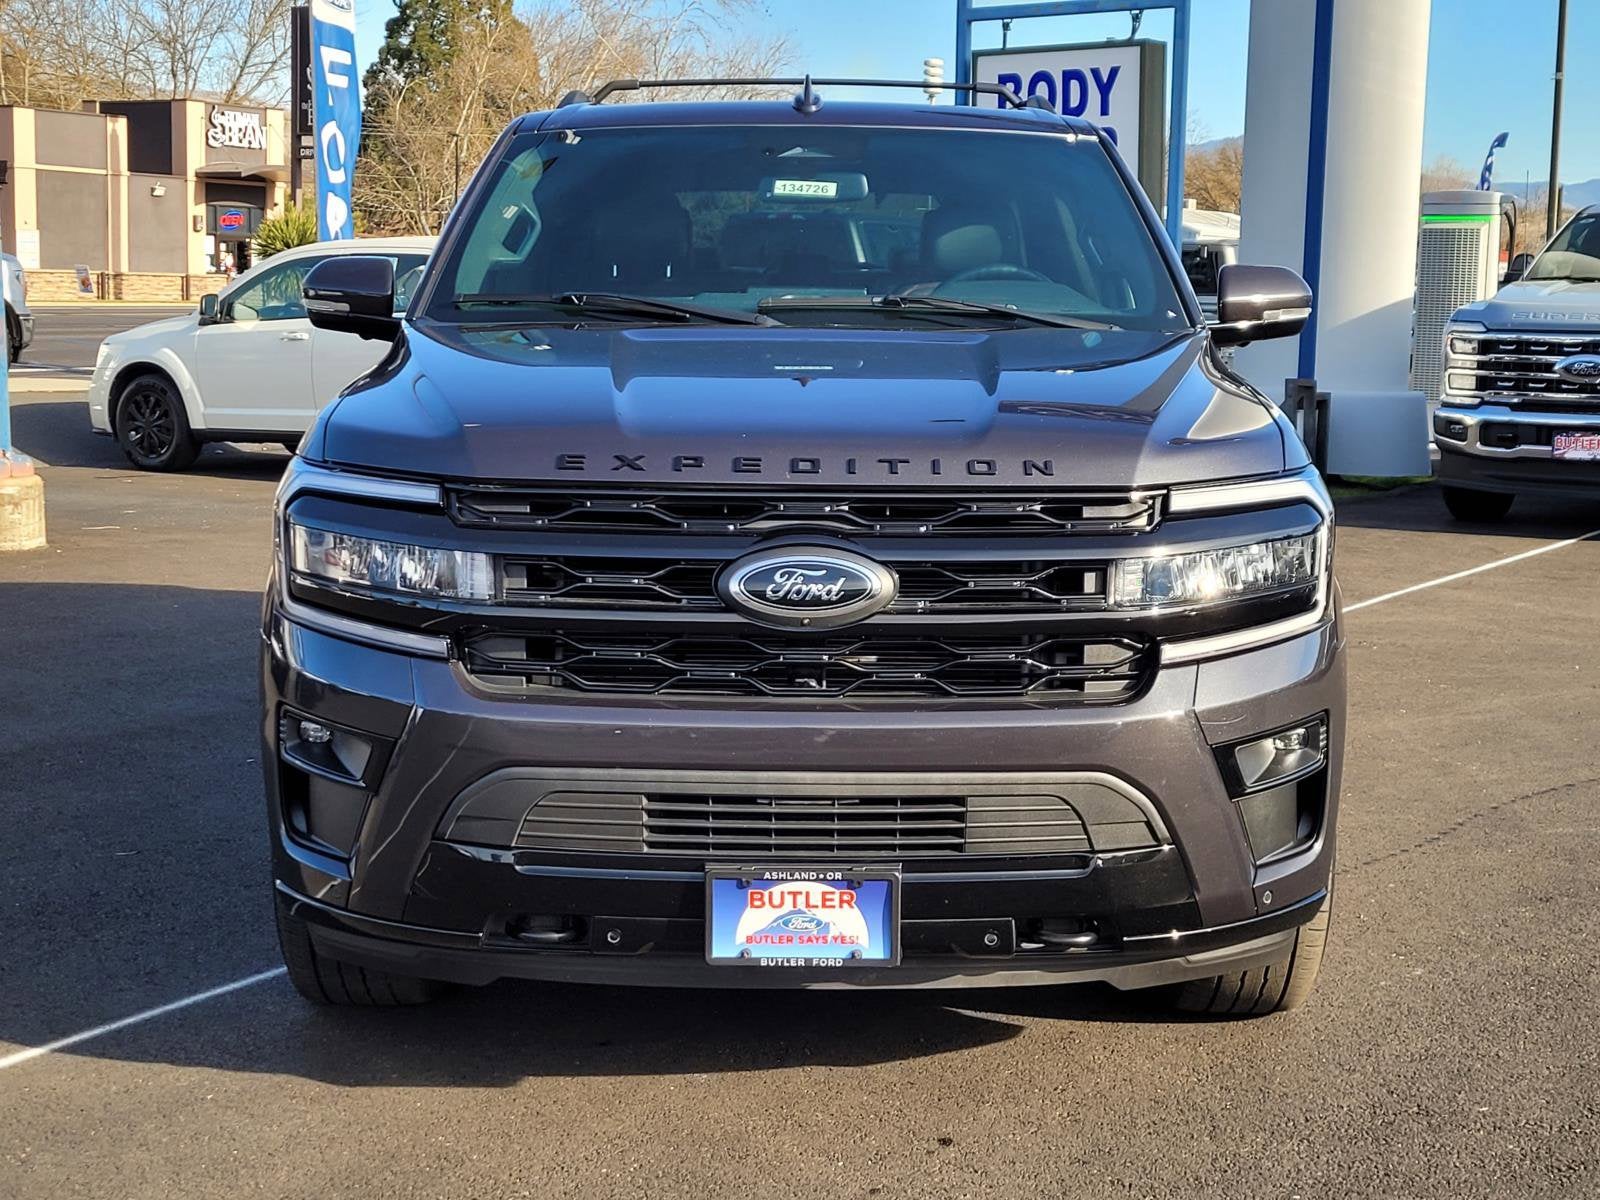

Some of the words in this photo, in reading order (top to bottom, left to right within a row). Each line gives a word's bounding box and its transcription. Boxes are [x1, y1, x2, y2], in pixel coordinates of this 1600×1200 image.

[997, 65, 1121, 118] BODY
[224, 125, 267, 149] BEAN
[220, 215, 244, 225] OPEN
[556, 454, 1056, 477] EXPEDITION
[766, 568, 846, 600] Ford
[764, 872, 817, 880] ASHLAND
[826, 872, 843, 880] OR
[749, 891, 856, 909] BUTLER
[788, 917, 817, 929] Ford
[746, 935, 793, 944] BUTLER
[799, 935, 828, 944] SAYS
[832, 935, 859, 945] YES!
[760, 958, 805, 966] BUTLER
[813, 958, 843, 966] FORD
